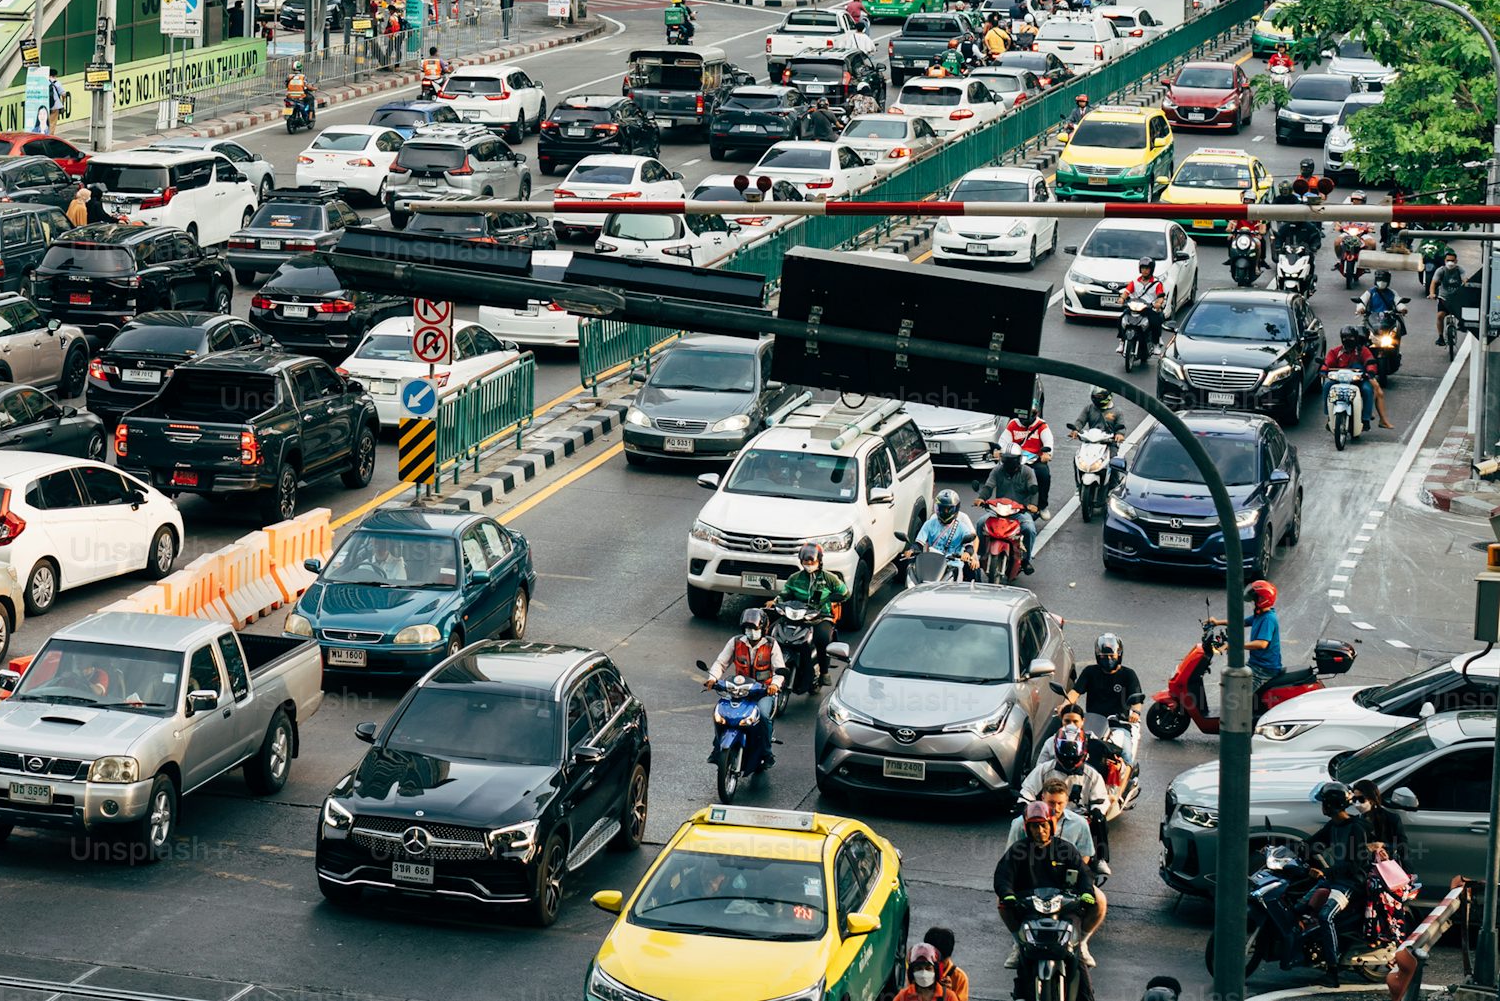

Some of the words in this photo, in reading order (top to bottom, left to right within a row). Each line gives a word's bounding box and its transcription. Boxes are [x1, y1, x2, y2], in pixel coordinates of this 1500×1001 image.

[119, 79, 131, 106] 5G
[136, 72, 156, 102] NO.1
[205, 58, 215, 87] IN
[216, 50, 258, 84] THAILAND
[345, 651, 363, 660] 1600
[414, 865, 430, 876] 686
